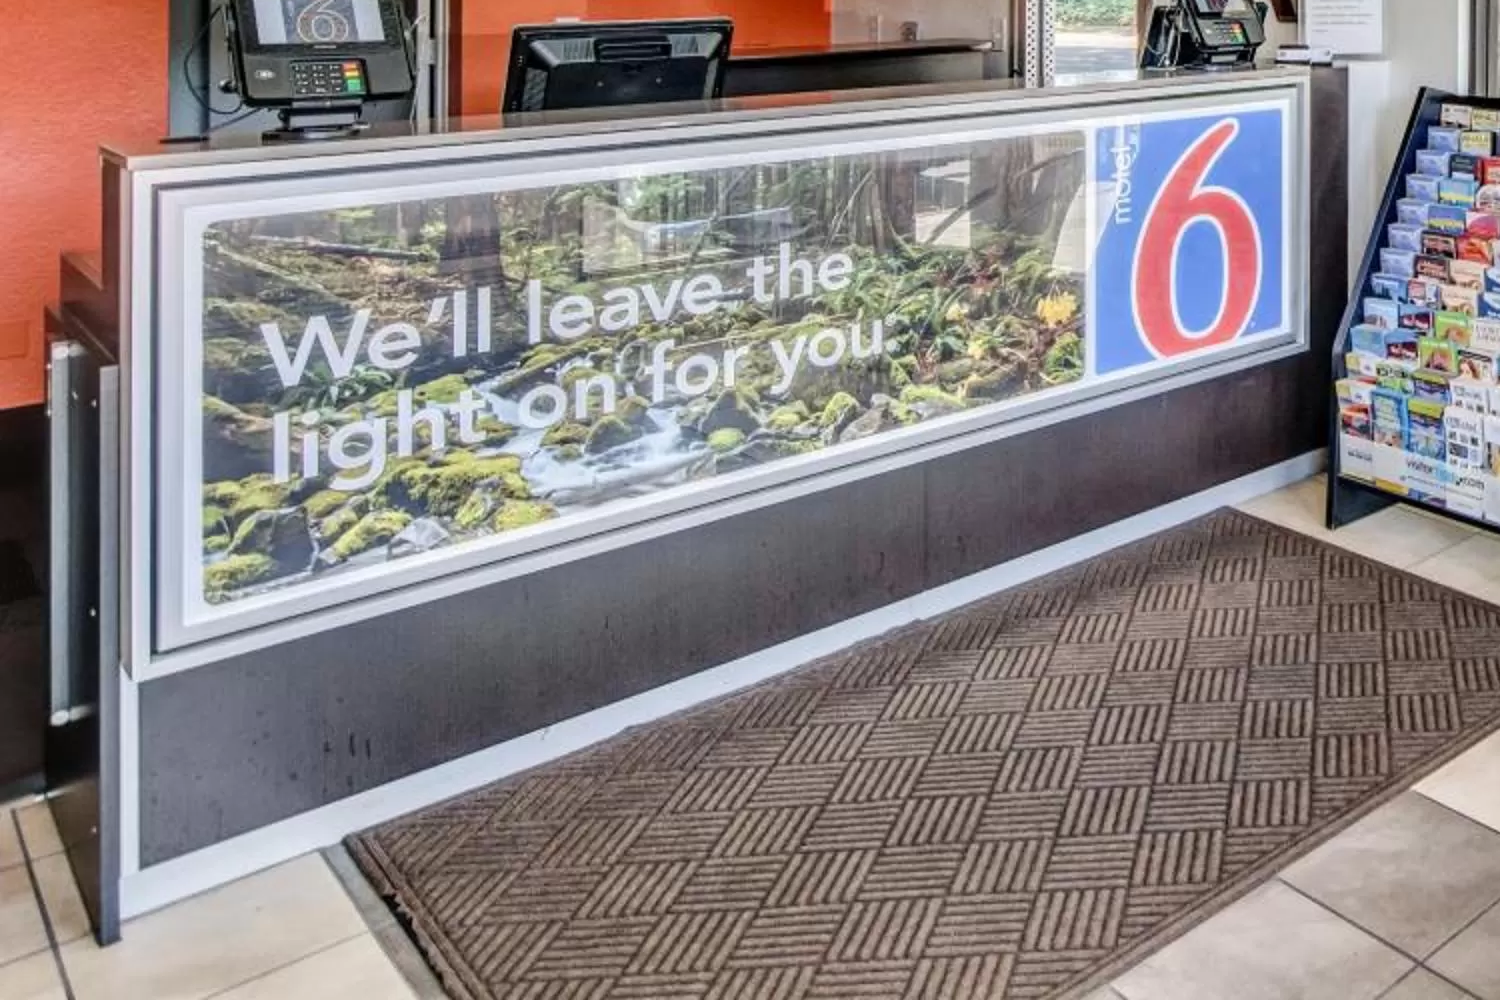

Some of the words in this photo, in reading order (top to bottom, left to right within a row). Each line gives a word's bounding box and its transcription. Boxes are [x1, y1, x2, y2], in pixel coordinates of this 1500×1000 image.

[1110, 146, 1133, 225] motel
[1131, 117, 1263, 361] 6
[260, 286, 491, 388] We'll
[528, 273, 723, 345] leave
[746, 242, 854, 303] the
[273, 390, 488, 491] light
[518, 373, 617, 429] on
[643, 339, 748, 401] for
